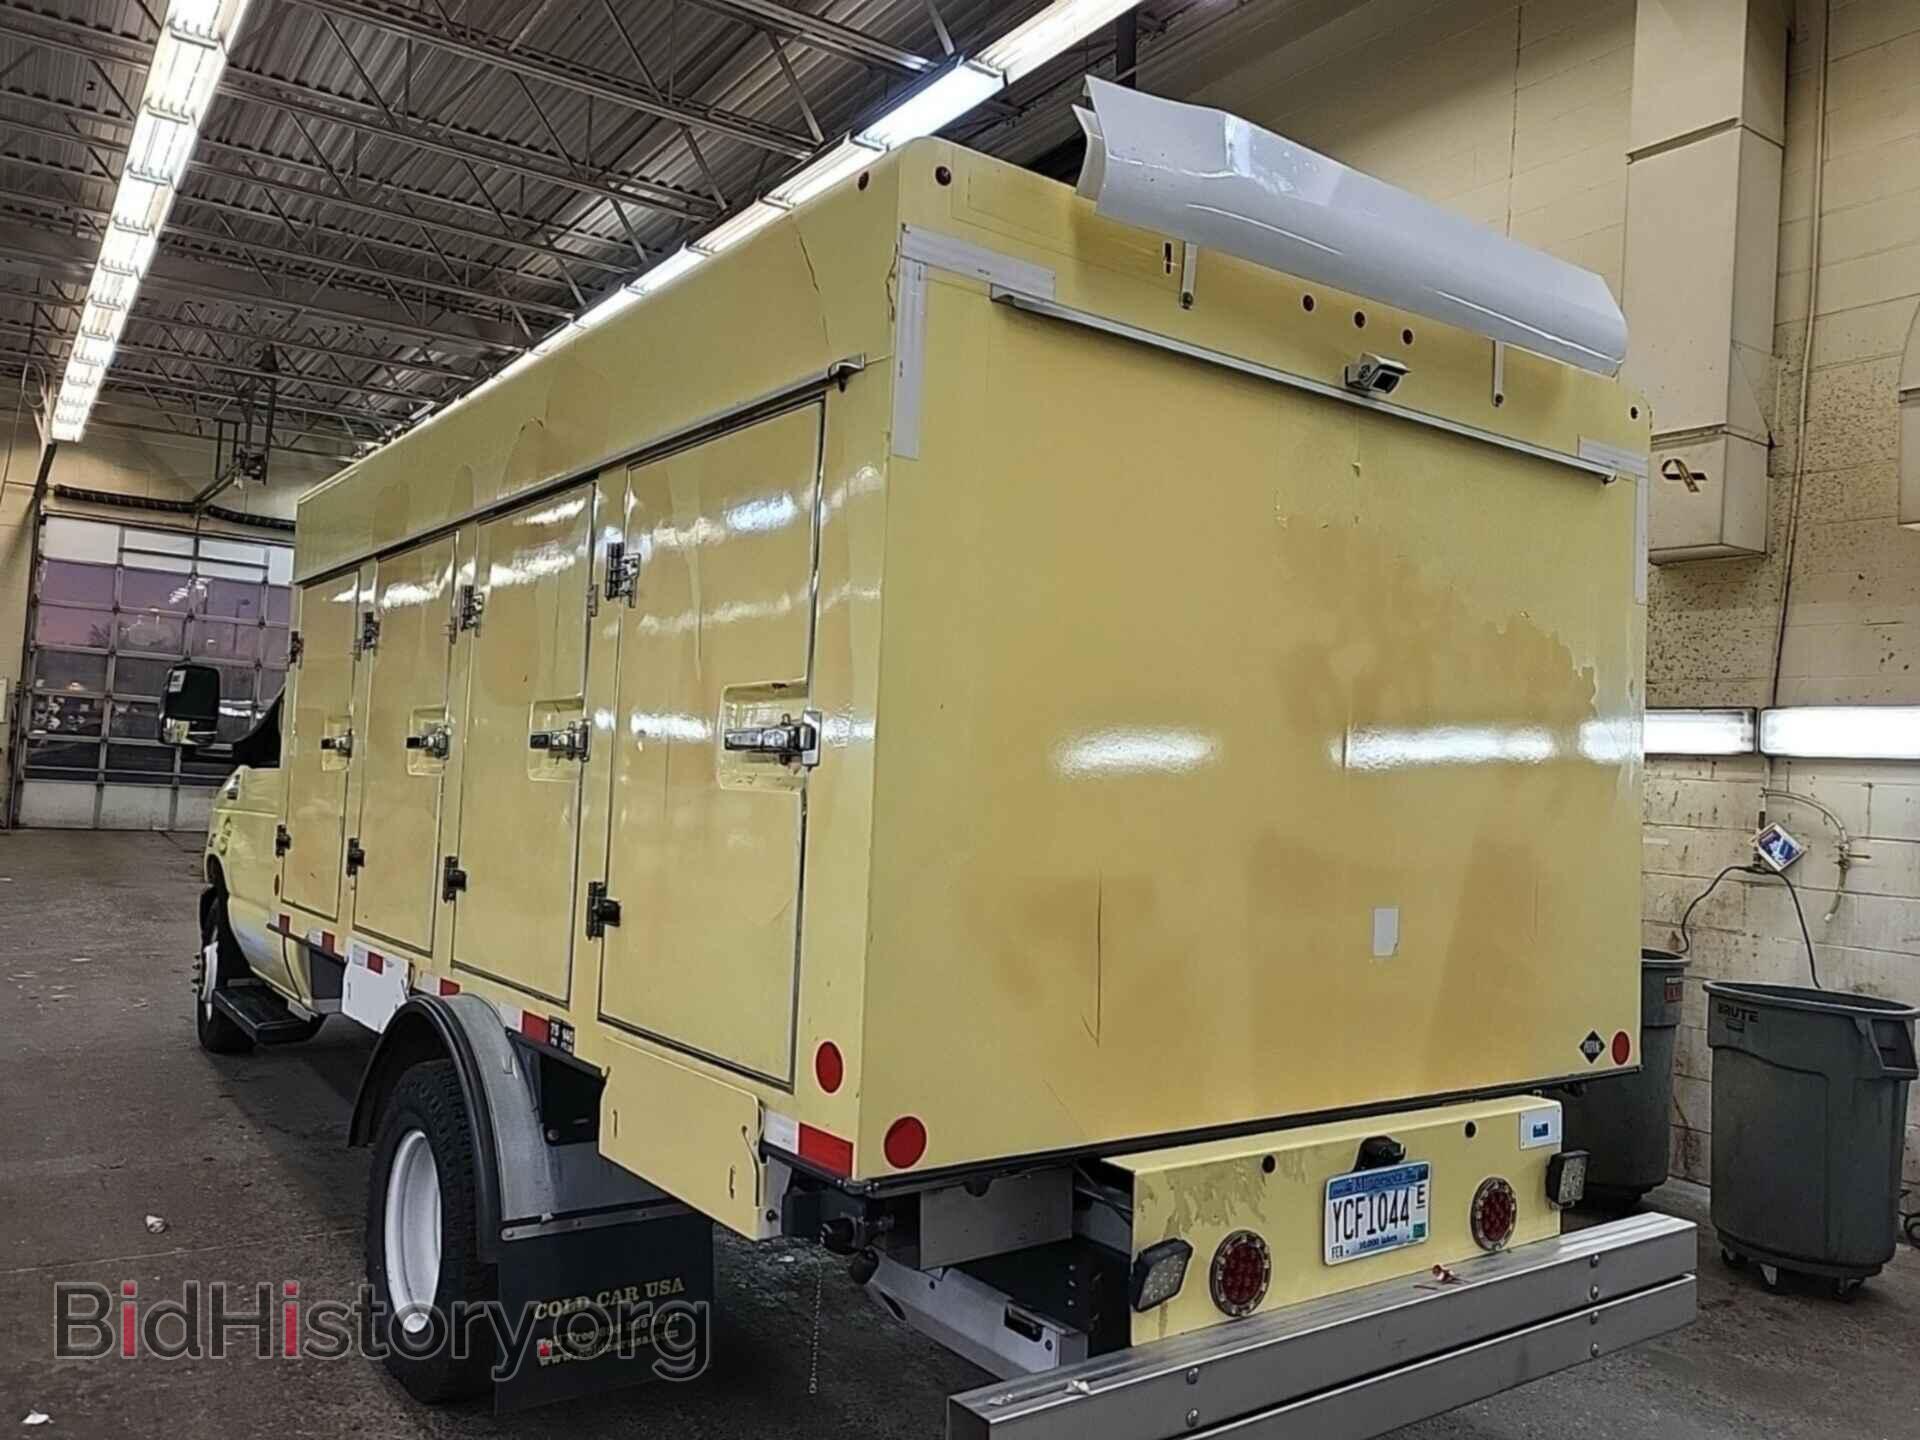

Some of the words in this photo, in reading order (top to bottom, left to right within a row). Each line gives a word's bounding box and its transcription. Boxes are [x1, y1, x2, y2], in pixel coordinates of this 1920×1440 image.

[1717, 1002, 1759, 1024] BRUTE
[1416, 1184, 1426, 1204] E
[1332, 1187, 1410, 1243] YCF1044
[535, 1295, 591, 1320] COLD
[596, 1286, 640, 1307] CAR
[645, 1278, 685, 1298] USA
